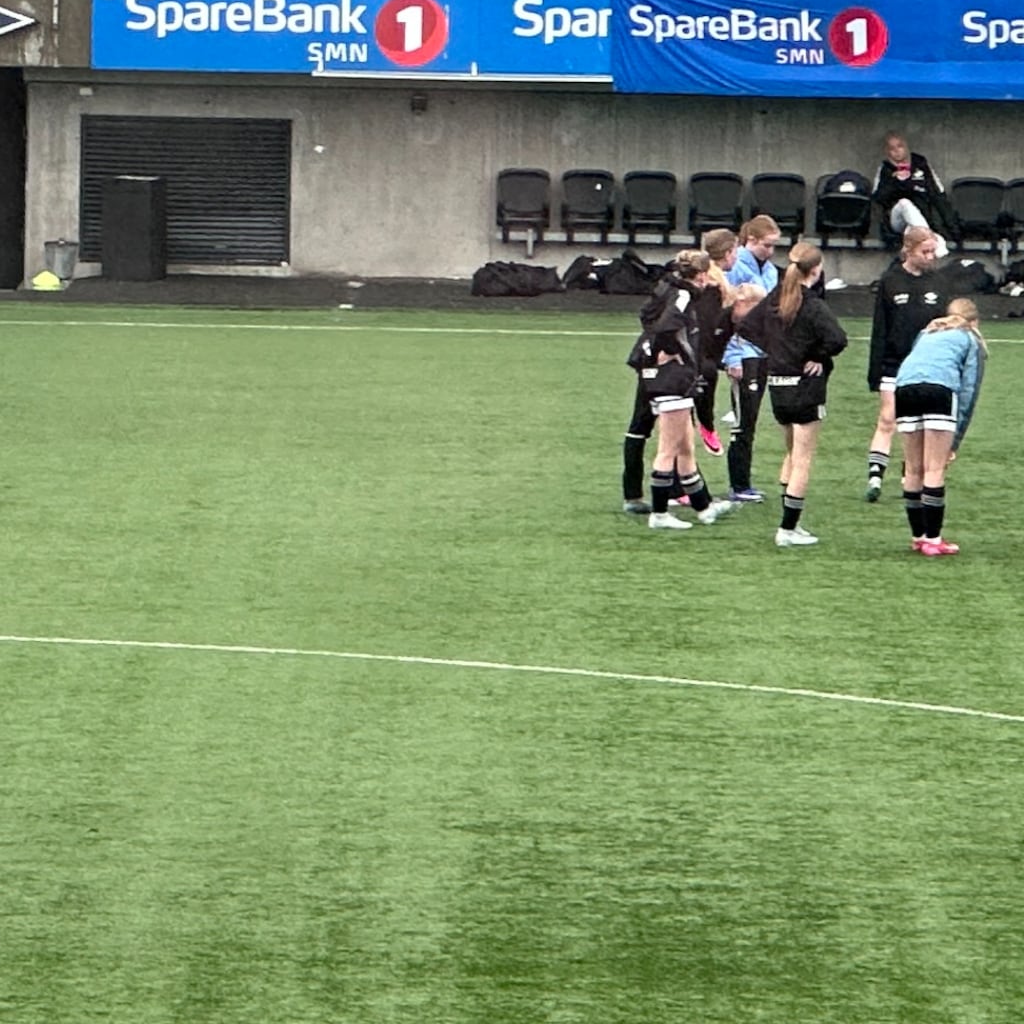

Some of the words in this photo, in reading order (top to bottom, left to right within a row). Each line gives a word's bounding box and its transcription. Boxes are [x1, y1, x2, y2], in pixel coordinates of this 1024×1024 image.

[396, 6, 423, 52] 1
[629, 4, 823, 43] SpareBank
[846, 18, 867, 56] 1
[307, 42, 368, 63] SMN
[776, 48, 824, 64] SMN
